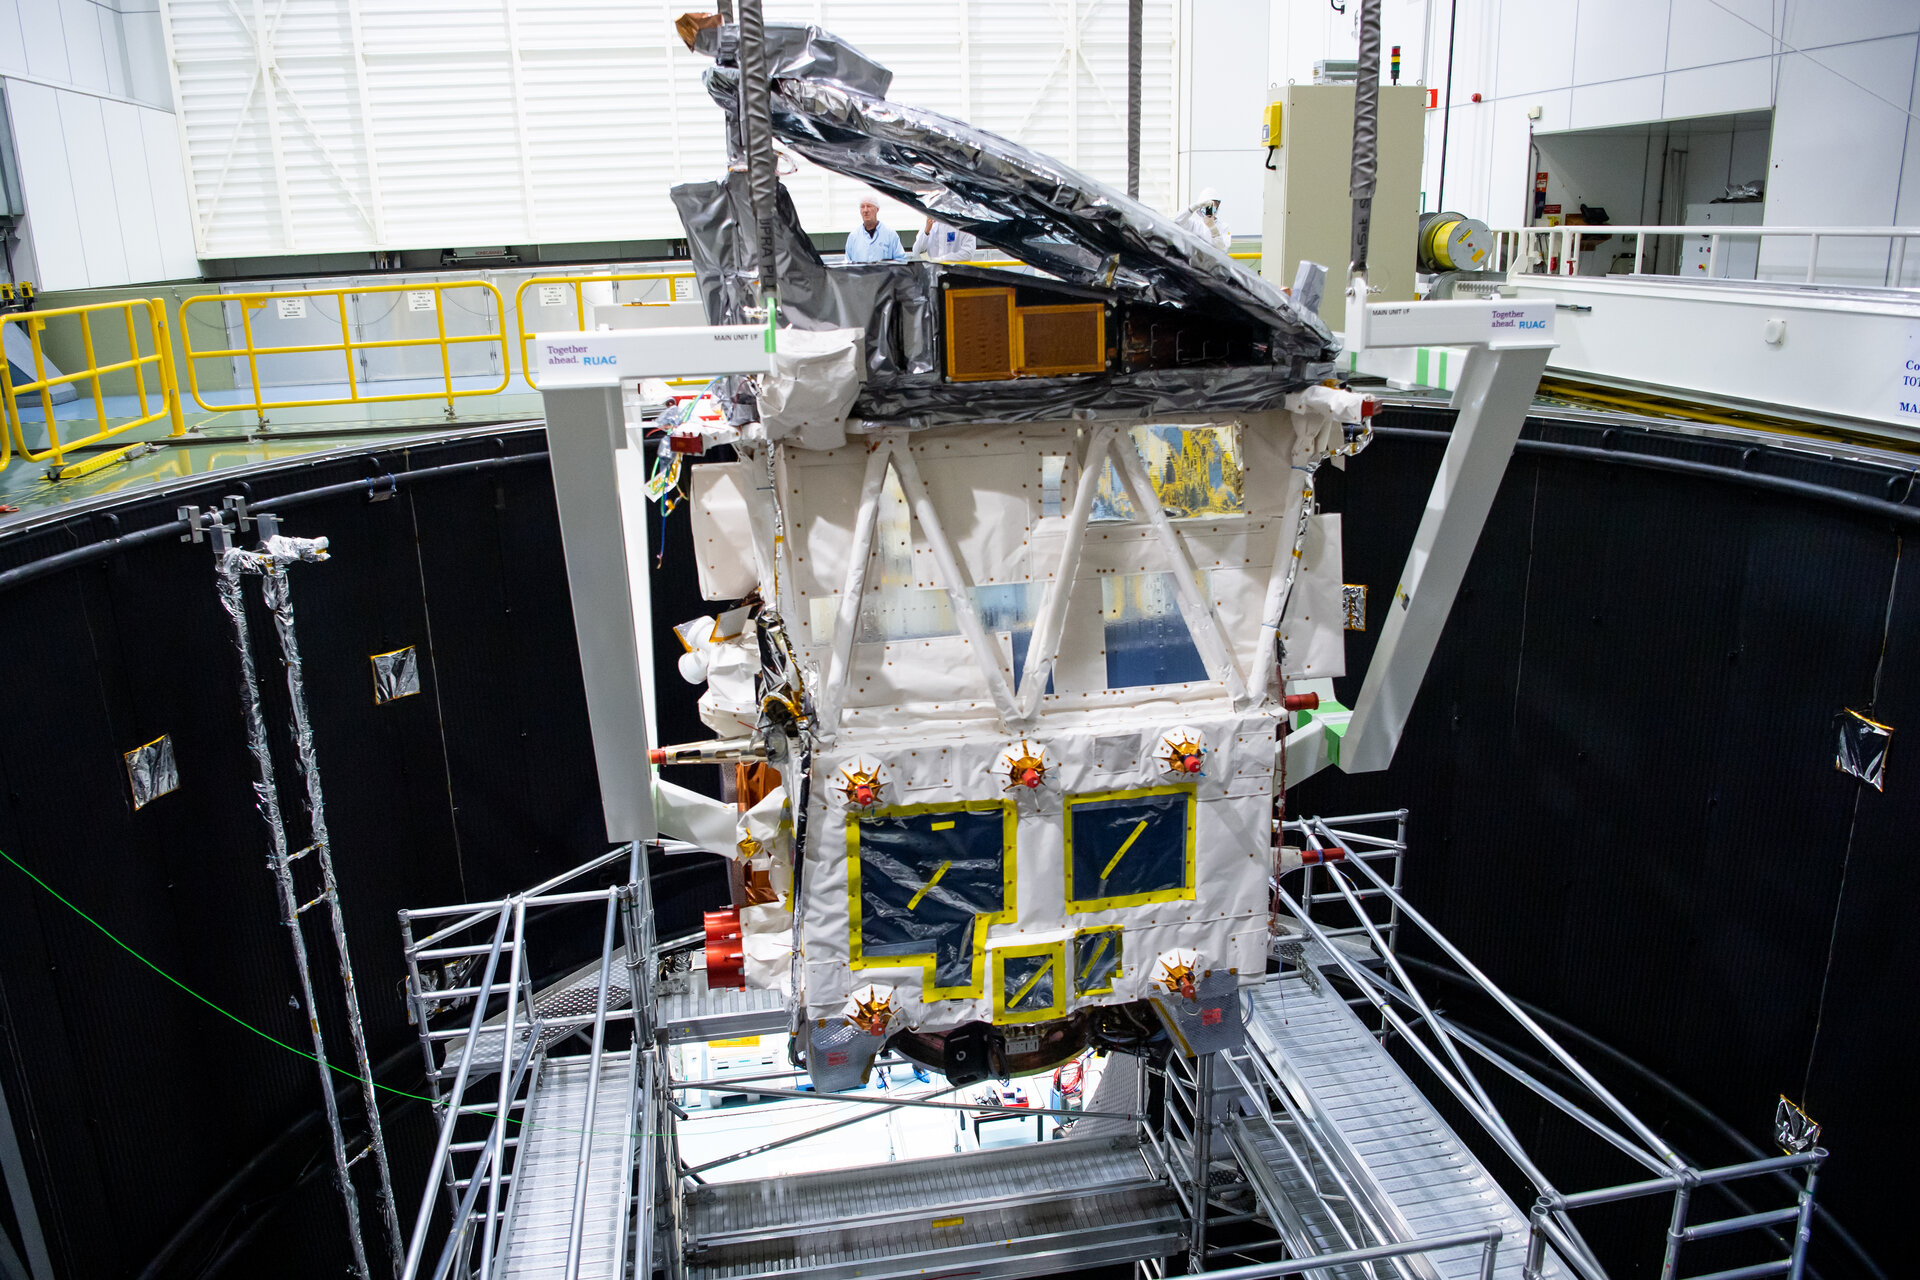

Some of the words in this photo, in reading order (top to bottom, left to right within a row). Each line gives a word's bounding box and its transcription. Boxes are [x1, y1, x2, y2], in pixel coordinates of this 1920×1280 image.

[1389, 308, 1402, 316] UNIT
[1491, 310, 1525, 320] Together
[1491, 319, 1516, 328] ahead.
[1518, 320, 1546, 329] RUAG
[733, 333, 749, 341] UNIT
[547, 345, 589, 356] Together
[548, 355, 580, 365] ahead.
[583, 355, 617, 366] RUAG
[1899, 401, 1920, 414] MA
